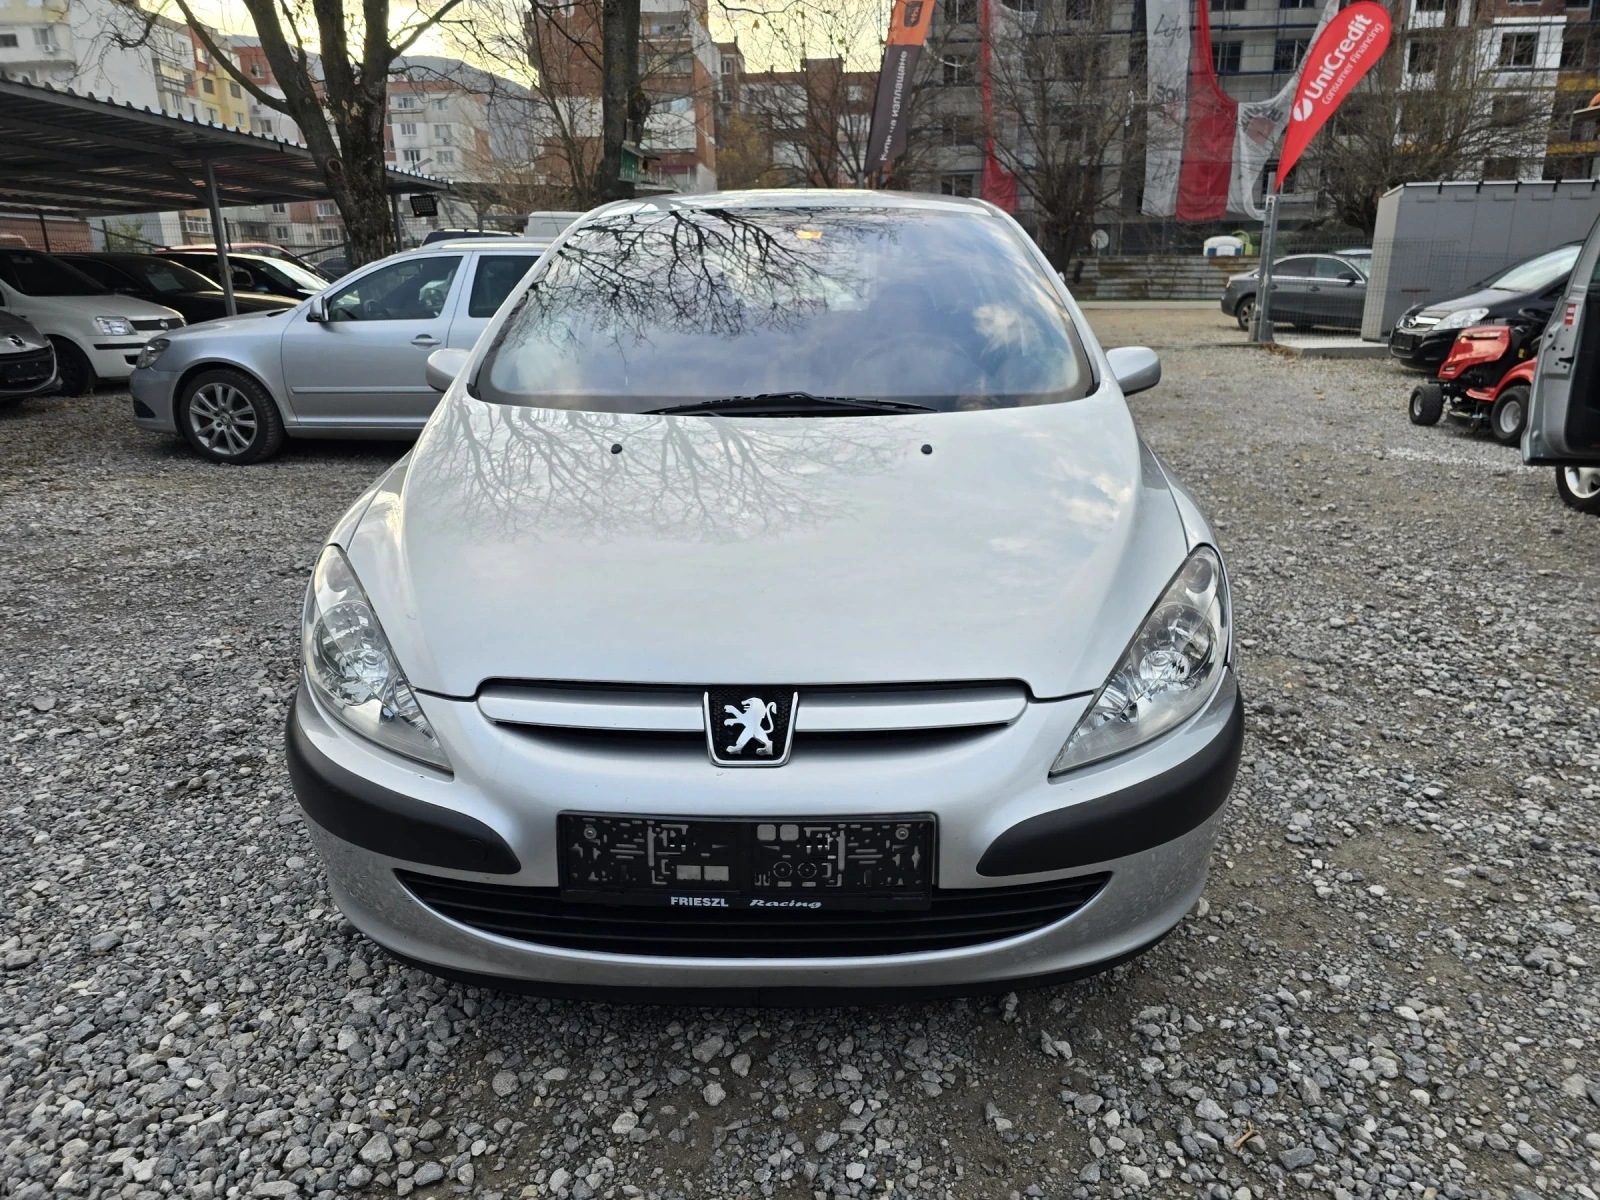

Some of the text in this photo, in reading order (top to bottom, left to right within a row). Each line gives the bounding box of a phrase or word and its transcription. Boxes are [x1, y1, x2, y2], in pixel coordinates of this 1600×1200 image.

[891, 51, 908, 118] изплащане
[1304, 13, 1373, 100] UniCredit
[1321, 23, 1385, 105] Consumer Financing
[670, 896, 822, 909] FRIESZL Racing
